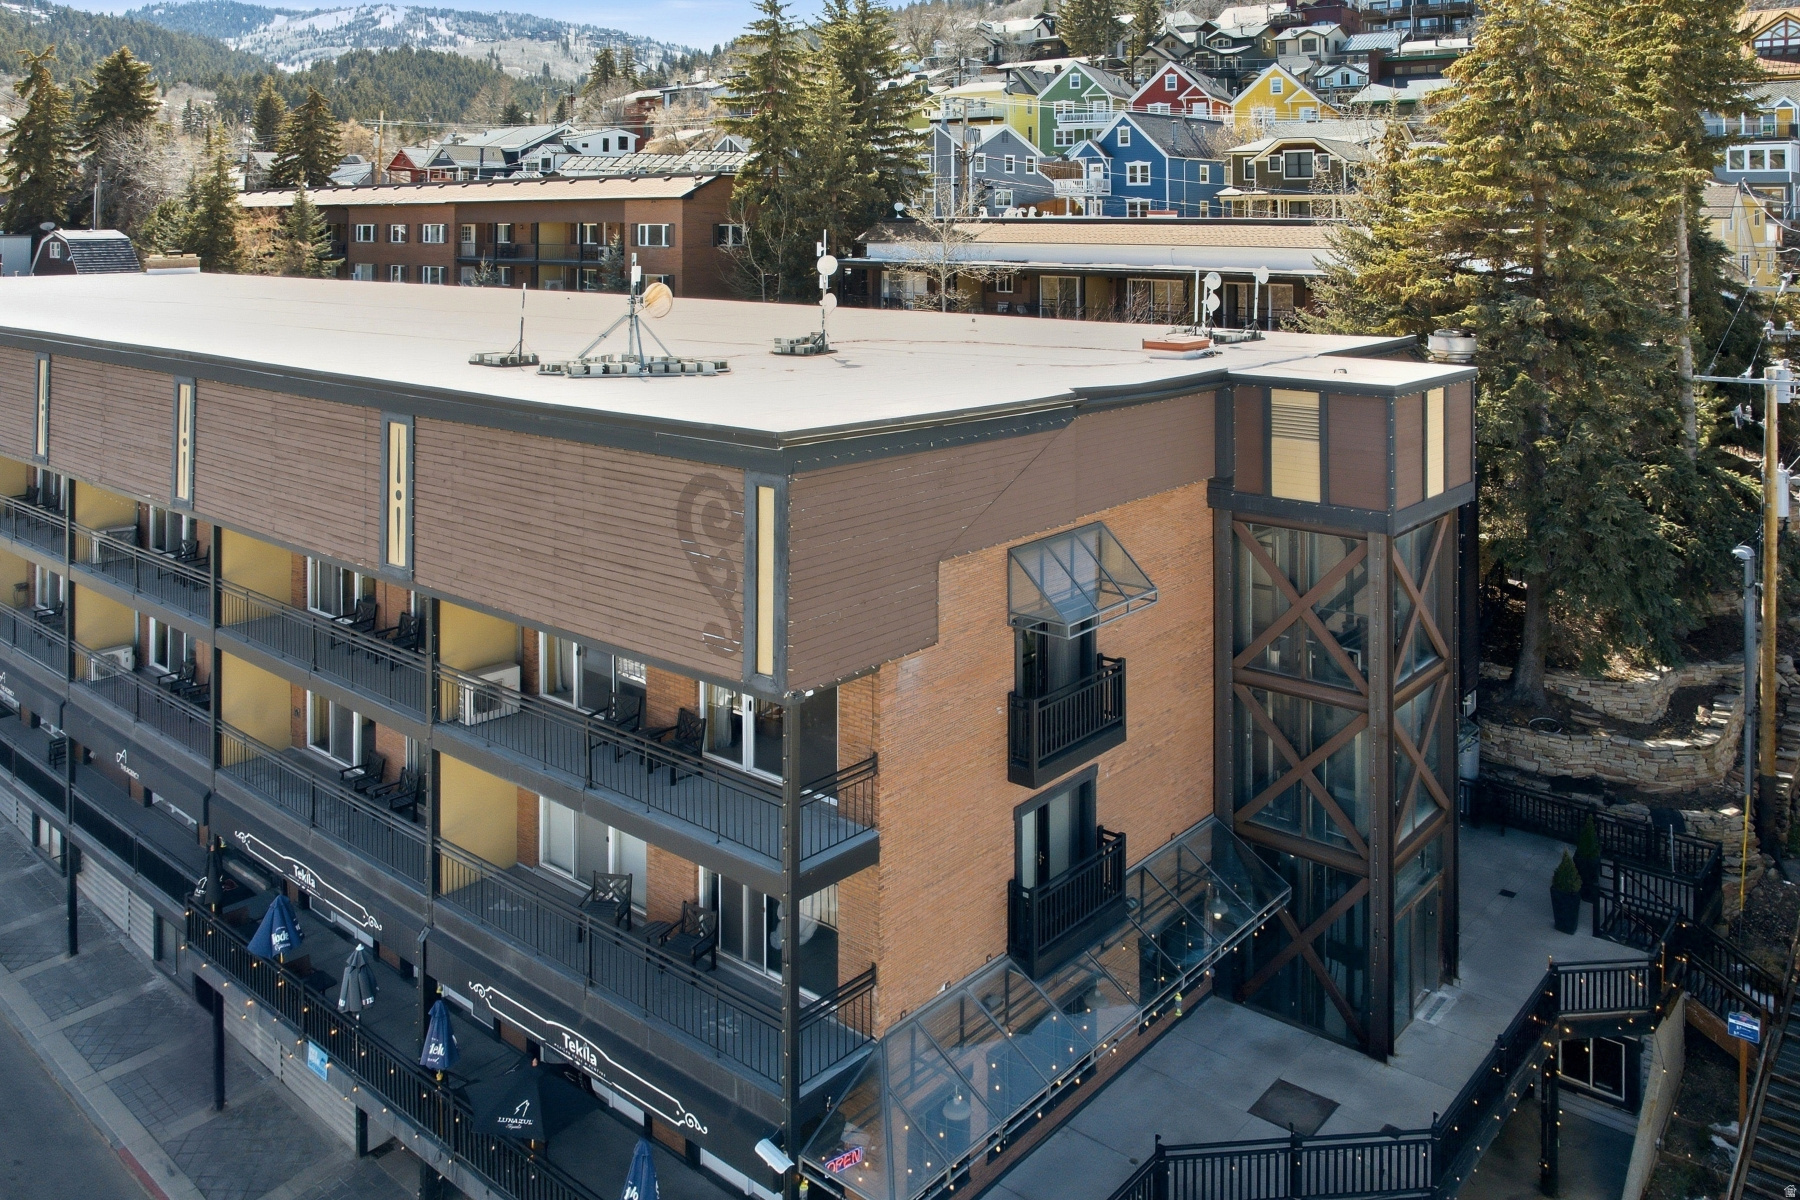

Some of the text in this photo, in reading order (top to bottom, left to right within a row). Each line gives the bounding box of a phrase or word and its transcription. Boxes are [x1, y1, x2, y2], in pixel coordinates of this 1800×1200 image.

[293, 864, 316, 889] Tekila
[561, 1032, 597, 1067] Tekila
[826, 1148, 860, 1173] OPEN
